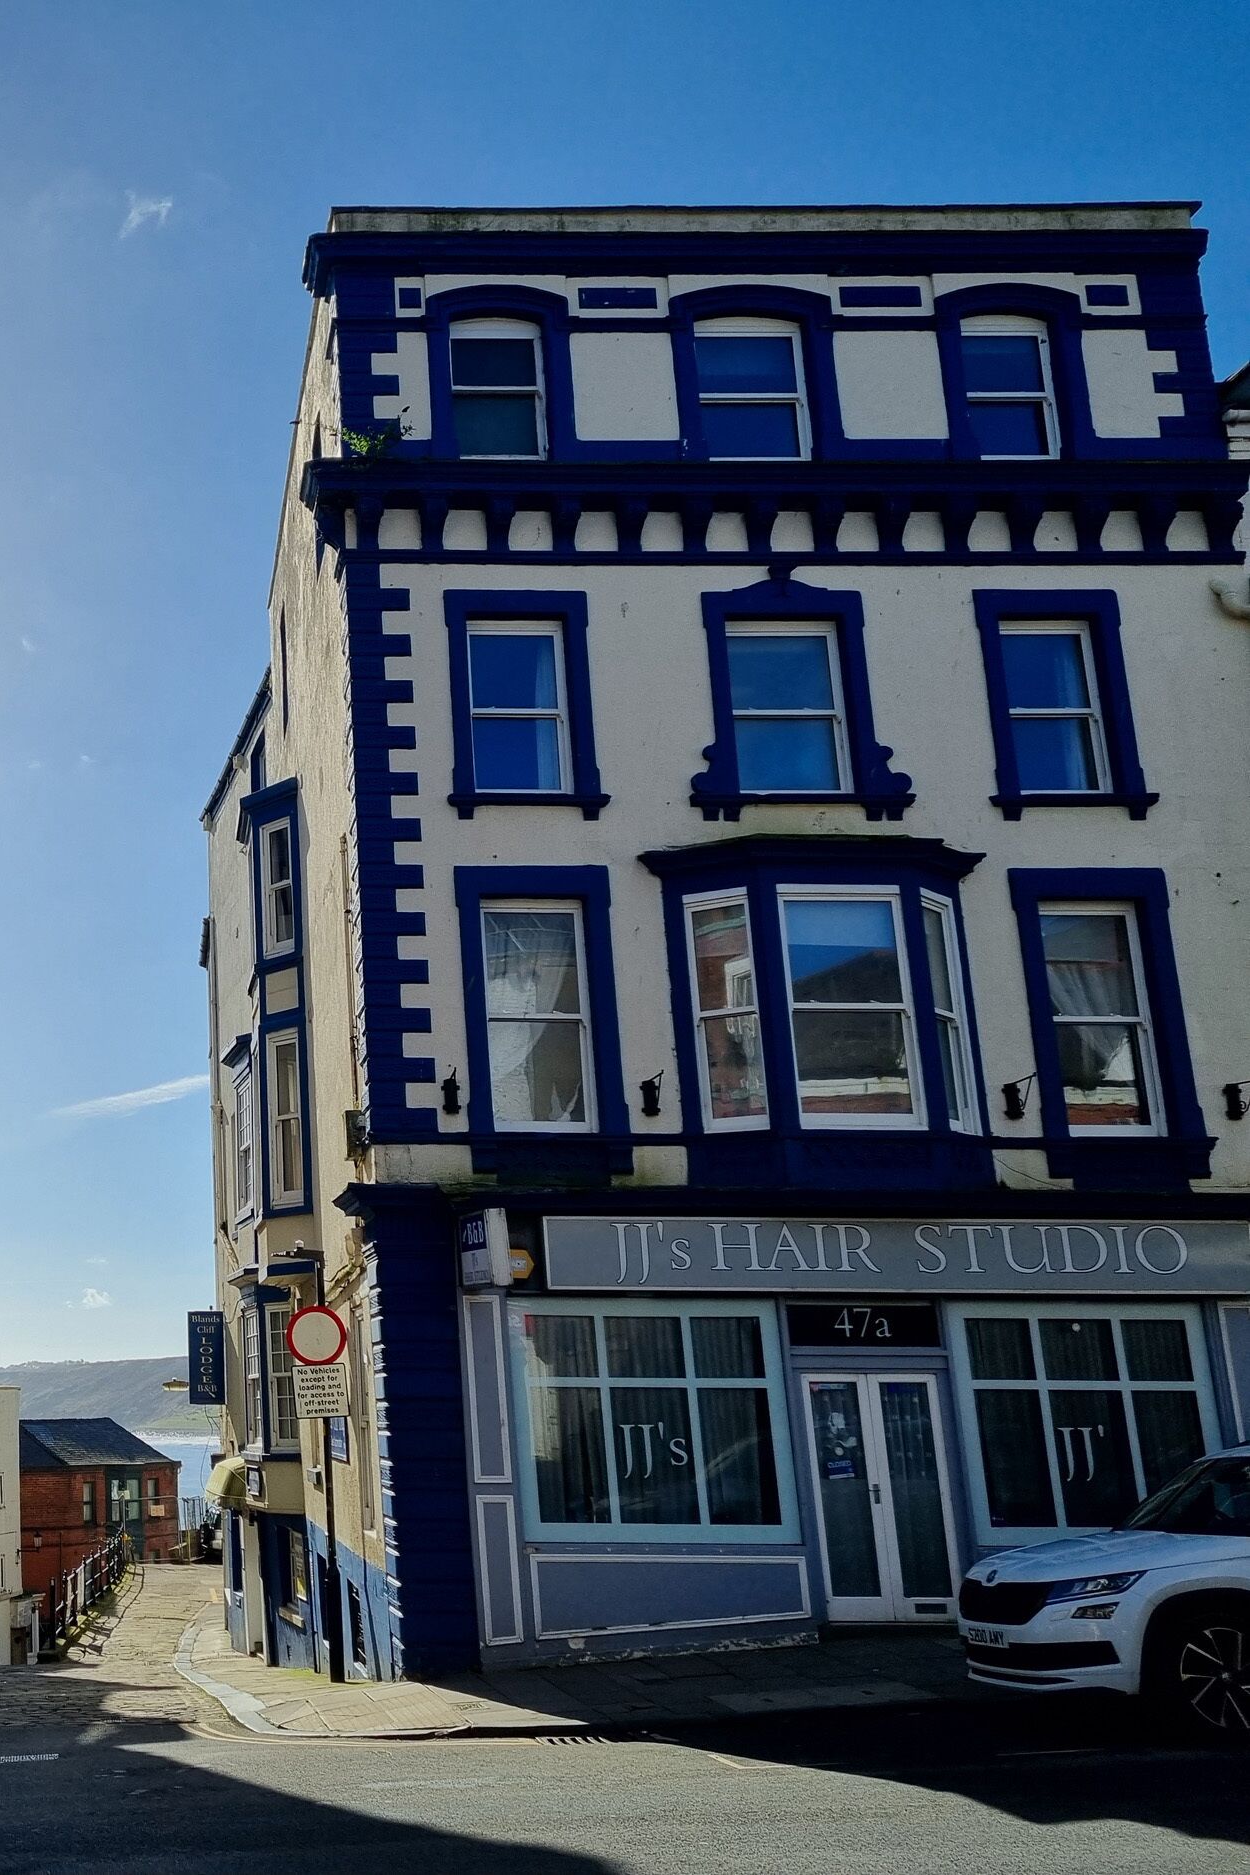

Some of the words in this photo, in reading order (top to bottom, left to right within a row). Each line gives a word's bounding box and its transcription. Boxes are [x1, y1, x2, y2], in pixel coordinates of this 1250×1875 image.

[610, 1221, 692, 1284] JJ's
[707, 1222, 882, 1273] HAIR
[914, 1224, 1188, 1275] STUDIO
[191, 1315, 220, 1323] Blands
[834, 1307, 892, 1338] 47a
[196, 1325, 215, 1334] Cliff
[199, 1336, 213, 1384] LODGE
[310, 1367, 340, 1375] Vehicles
[197, 1385, 217, 1397] B&B
[304, 1399, 339, 1407] off-street
[306, 1407, 339, 1415] premises
[619, 1421, 688, 1479] JJ's
